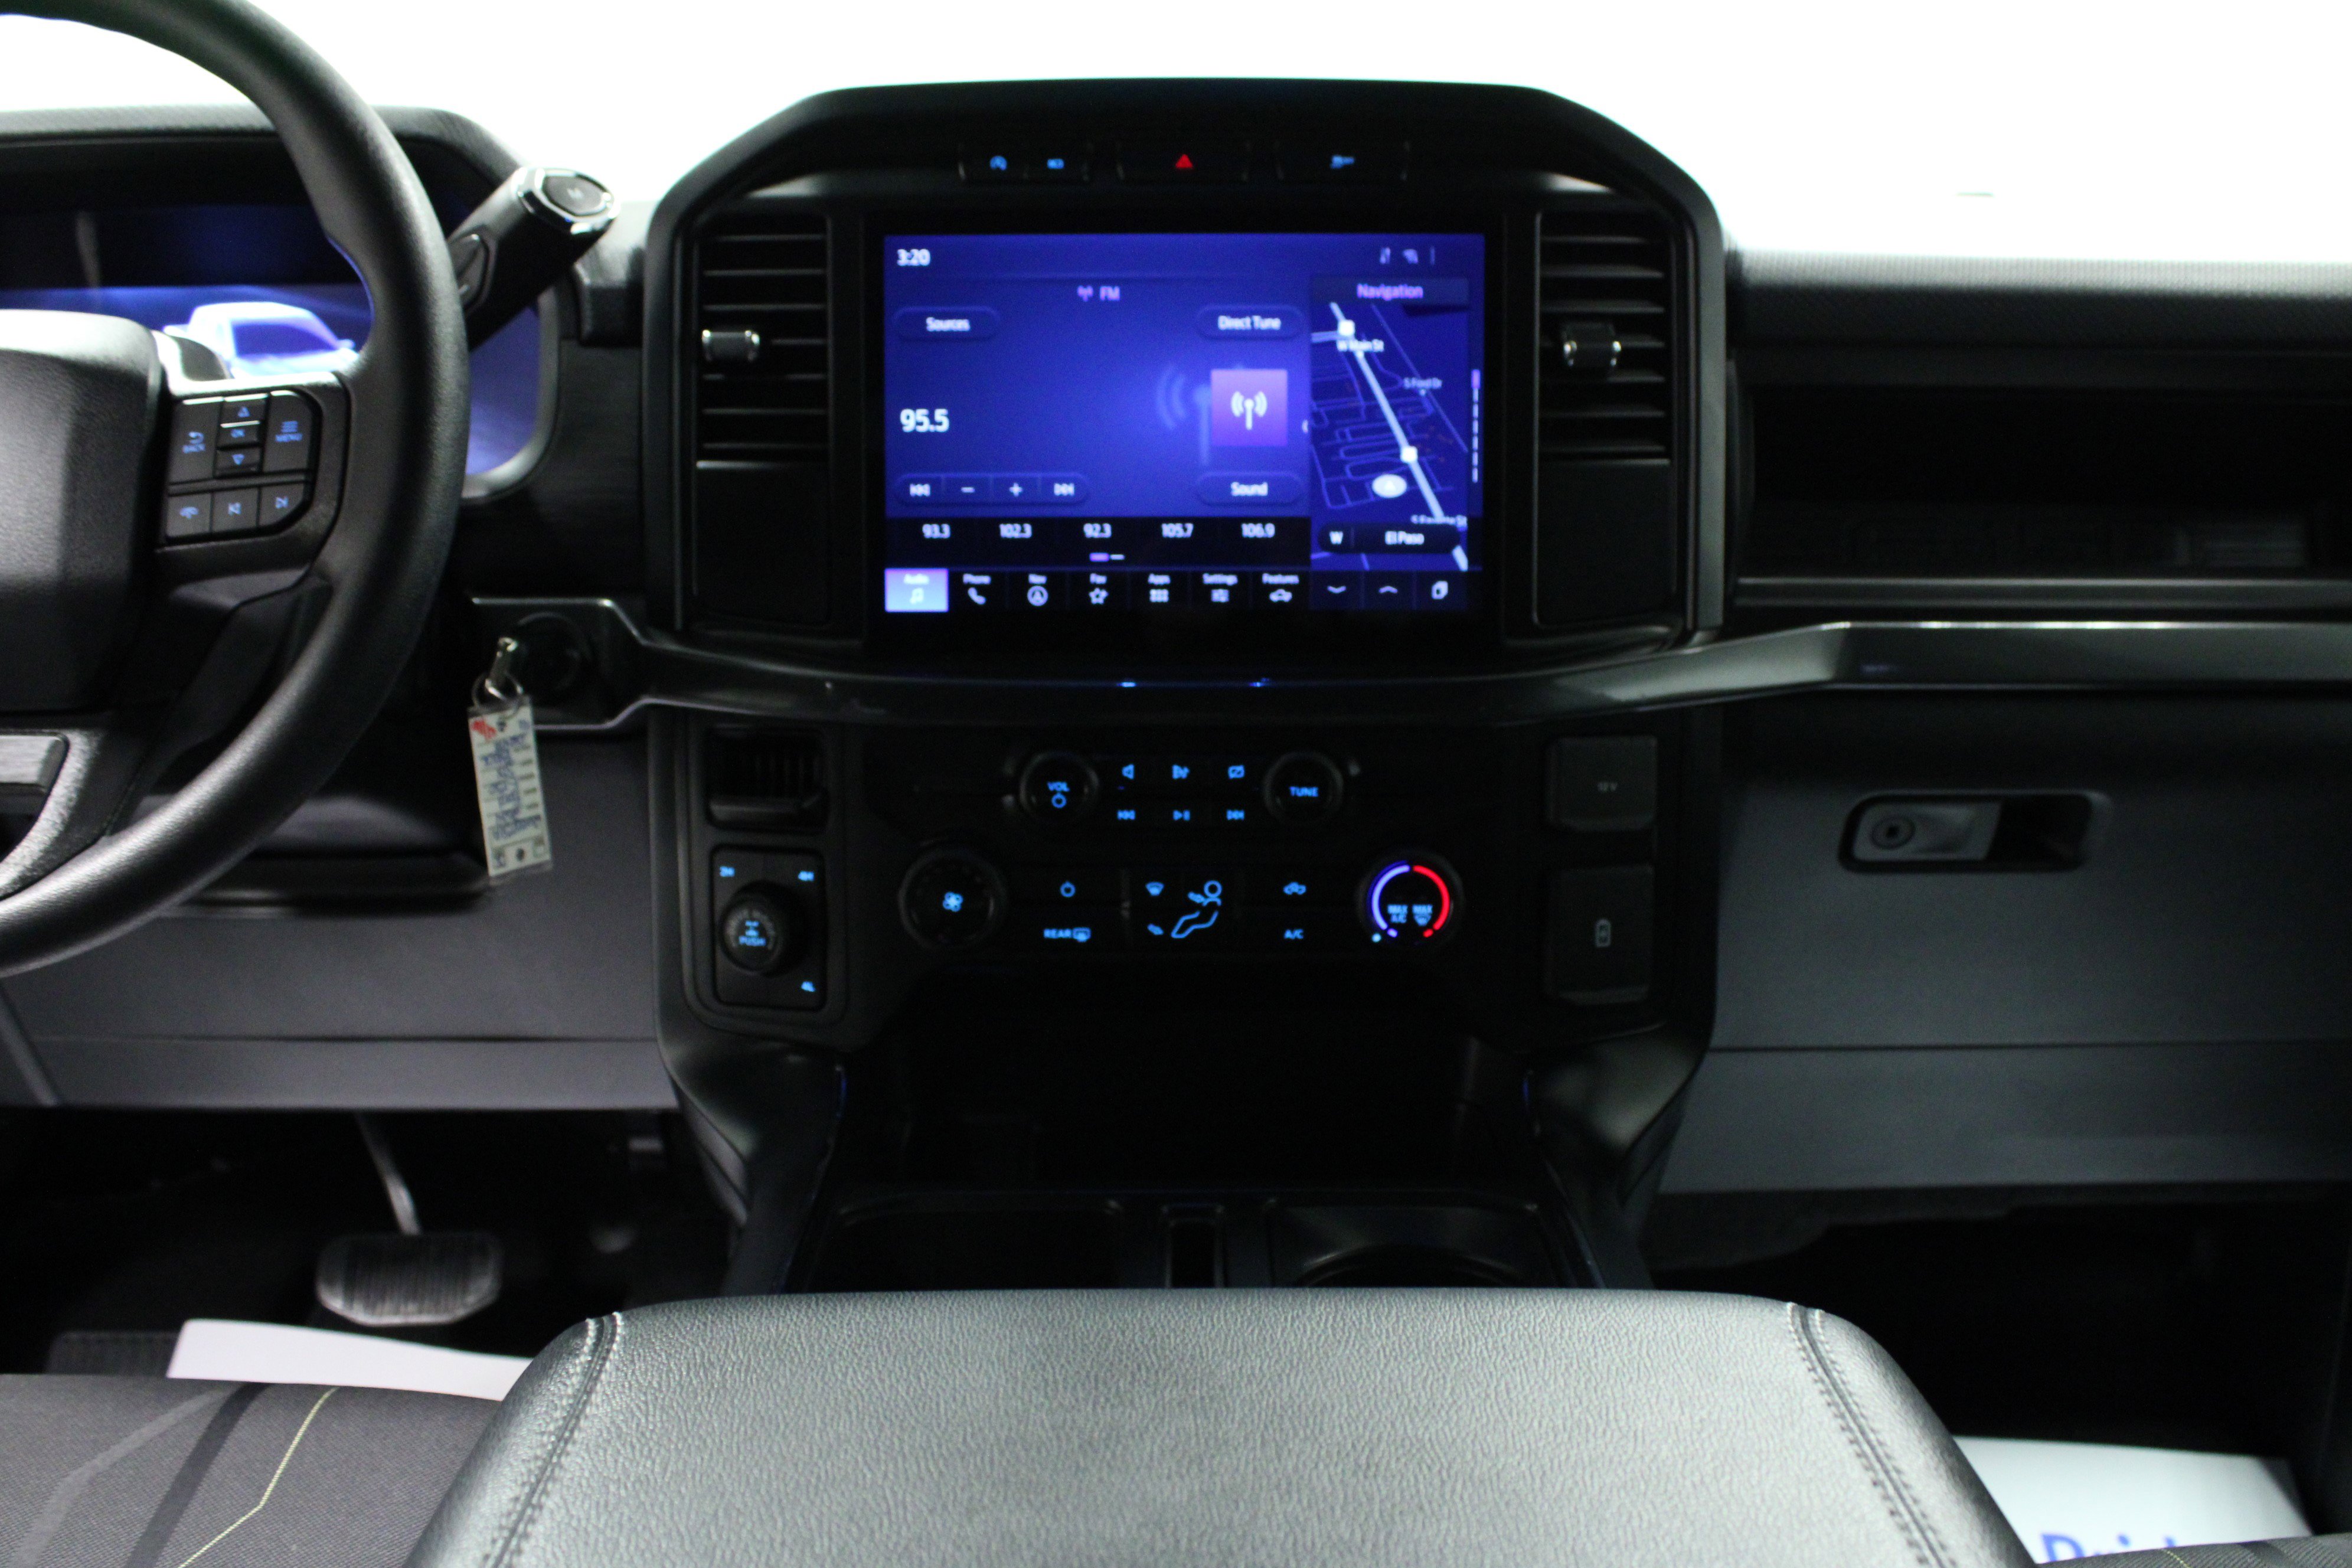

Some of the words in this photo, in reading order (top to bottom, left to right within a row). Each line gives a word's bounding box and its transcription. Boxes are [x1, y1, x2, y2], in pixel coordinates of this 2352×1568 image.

[897, 249, 931, 266] 3:20
[1099, 286, 1121, 301] FM
[1356, 283, 1424, 302] Navigation
[926, 317, 971, 332] Sources
[1217, 315, 1252, 331] Direct
[1253, 315, 1282, 331] Tune
[900, 408, 950, 433] 95.5
[1230, 481, 1269, 496] Sound
[922, 523, 951, 539] 93.3
[999, 523, 1033, 539] 102.3
[1083, 522, 1112, 539] 92.3
[1161, 522, 1194, 538] 105.7
[1241, 522, 1276, 538] 106.9
[1384, 530, 1397, 545] El
[1397, 530, 1425, 545] Paso
[1329, 531, 1344, 545] W
[962, 573, 992, 584] Phone
[1202, 573, 1238, 586] Settings
[1047, 780, 1070, 792] VOL
[1289, 786, 1319, 798] TUNE
[1043, 928, 1072, 939] REAR
[1283, 929, 1304, 939] A/C
